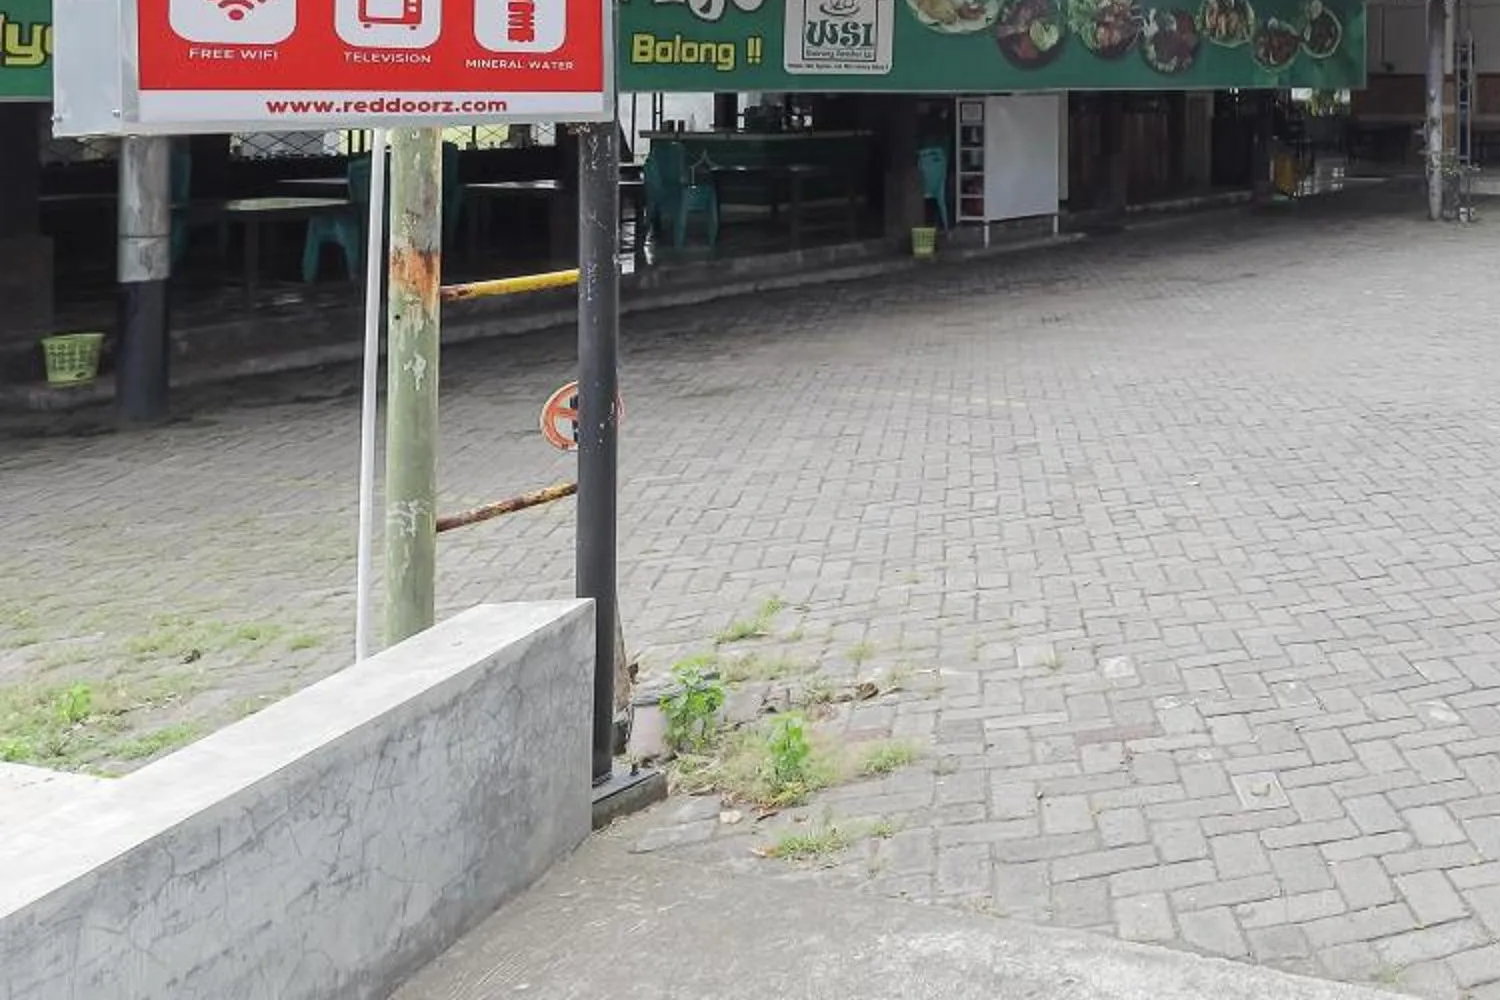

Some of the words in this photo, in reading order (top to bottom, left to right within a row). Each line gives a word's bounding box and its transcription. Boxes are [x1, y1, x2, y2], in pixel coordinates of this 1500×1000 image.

[806, 19, 874, 47] WSI
[188, 47, 233, 61] FREE
[240, 47, 279, 61] WIFI
[343, 51, 432, 65] TELEVISION
[465, 58, 523, 71] MINERAL
[528, 59, 575, 72] WATER
[266, 97, 507, 115] www.reddoorz.com
